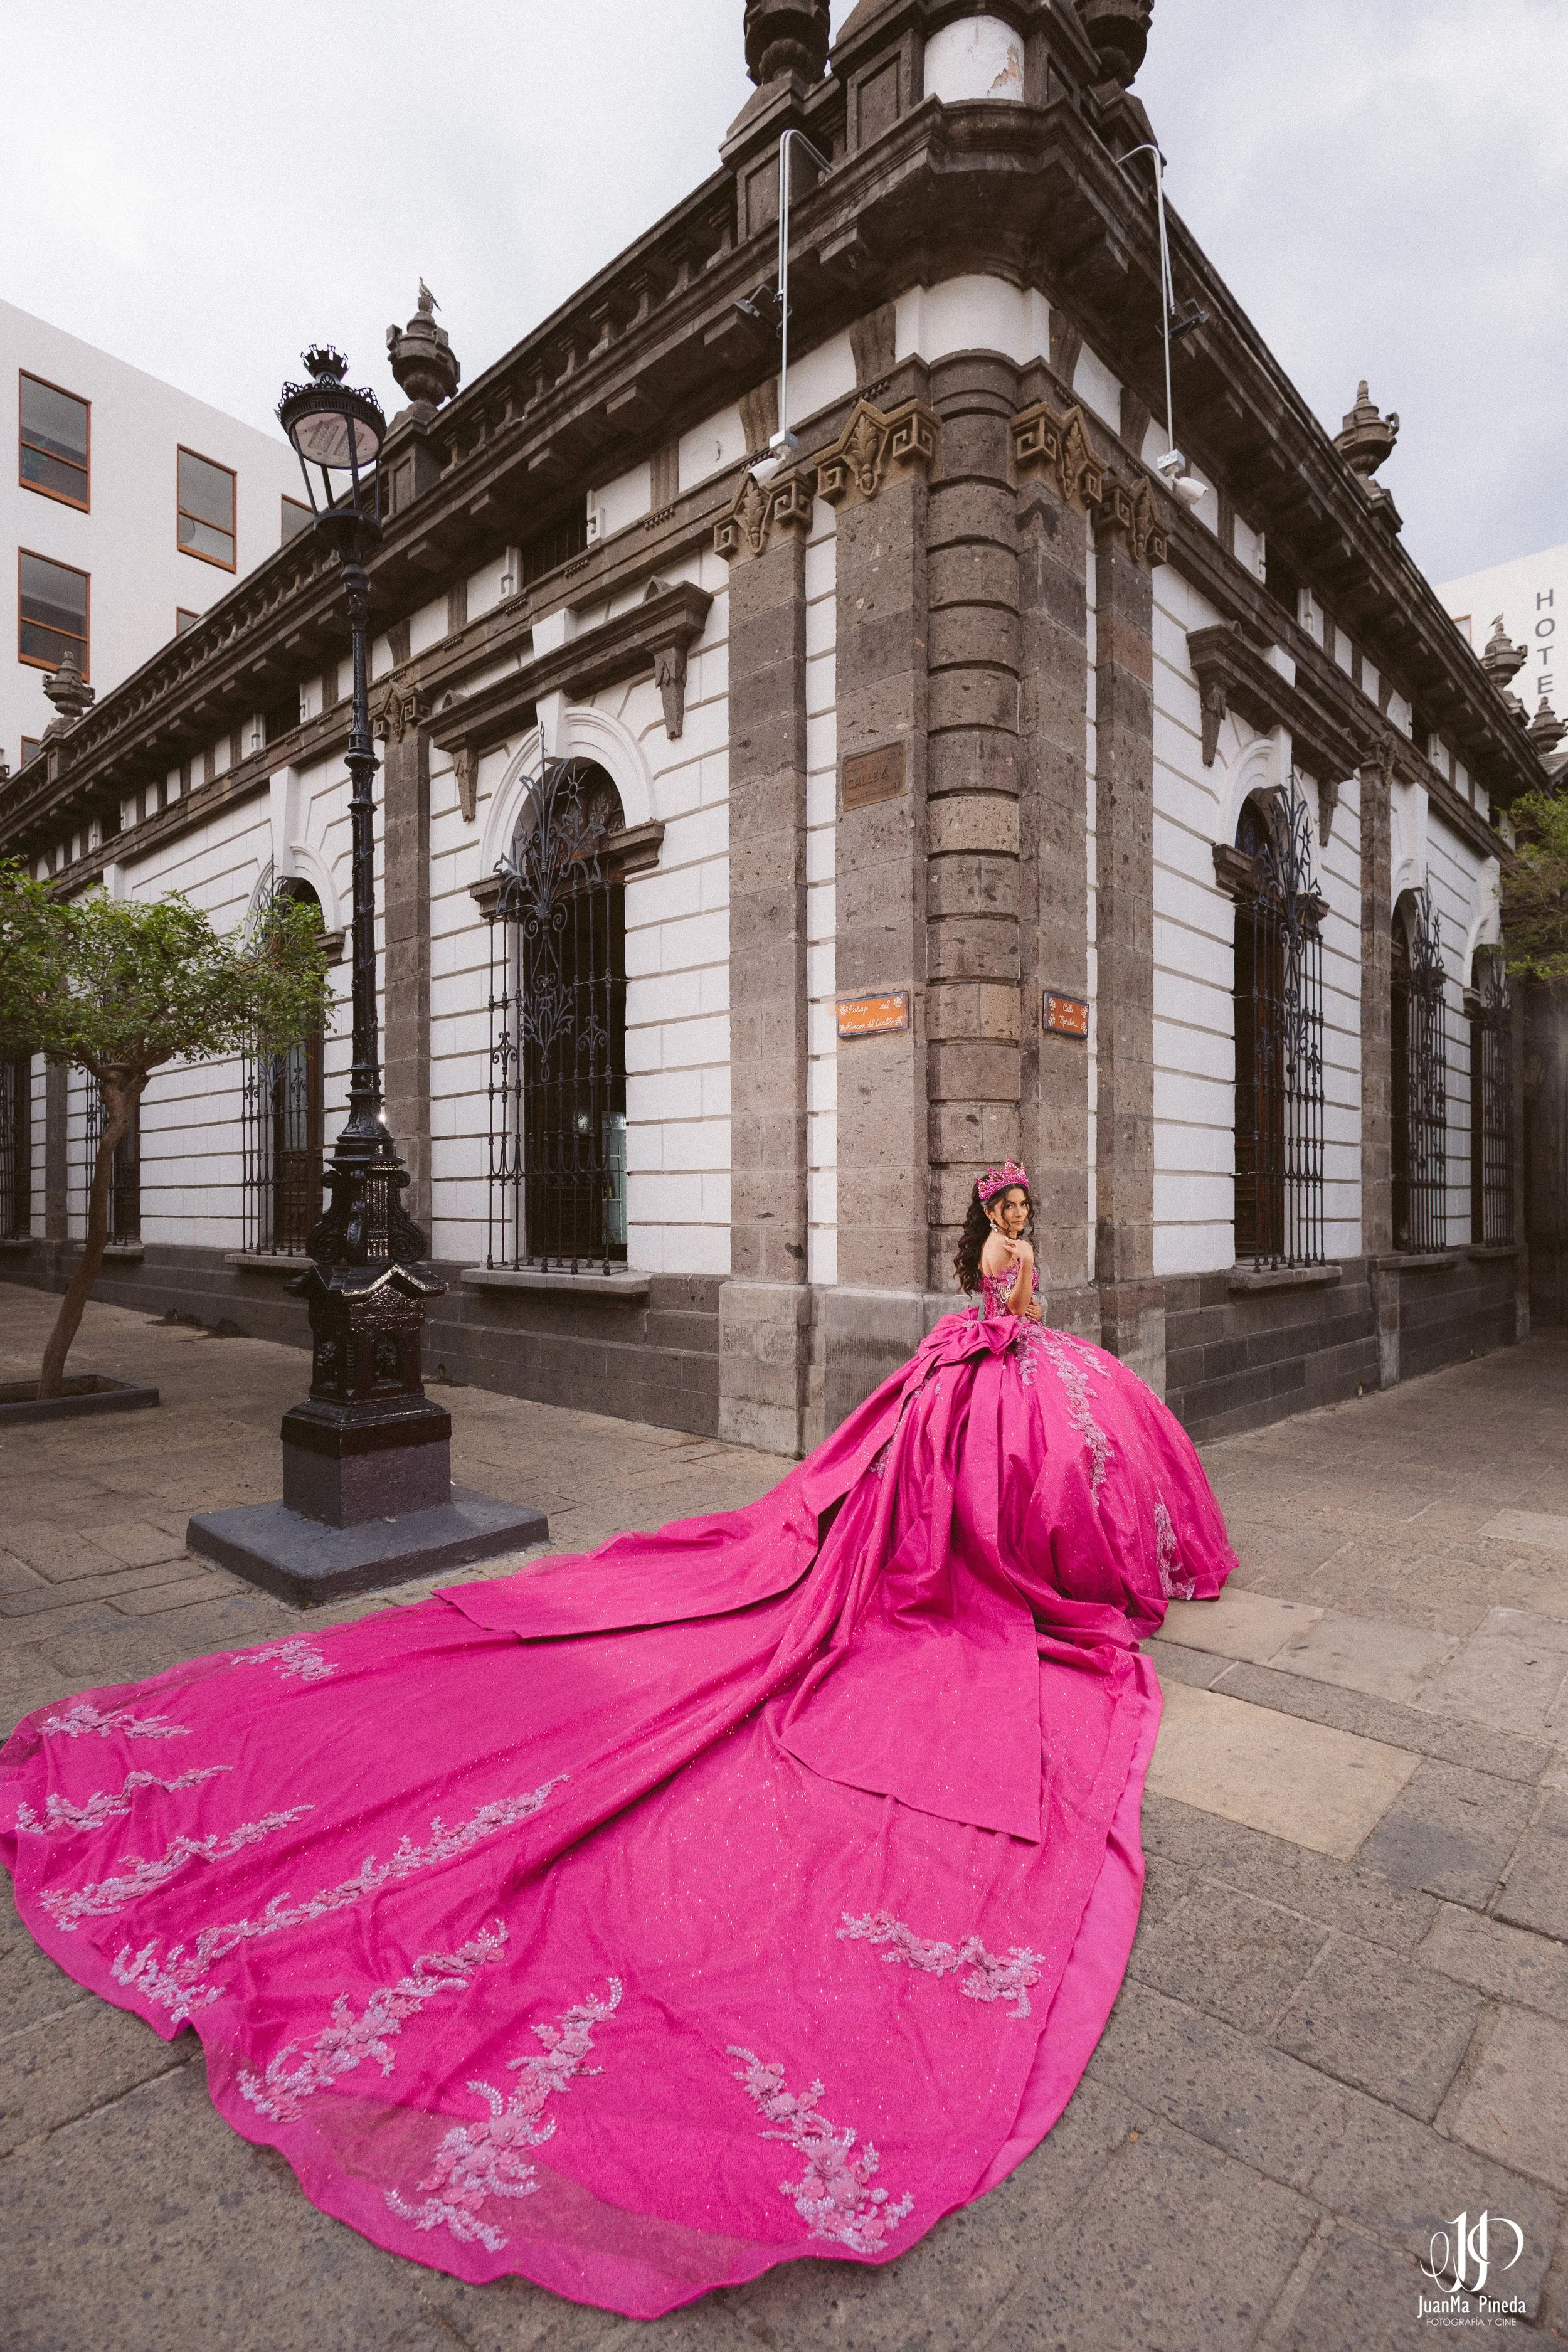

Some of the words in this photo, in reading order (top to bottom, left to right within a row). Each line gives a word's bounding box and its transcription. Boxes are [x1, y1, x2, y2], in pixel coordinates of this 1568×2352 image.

[1535, 589, 1555, 695] HOTE
[849, 771, 878, 789] CALLE
[881, 765, 889, 781] 4
[879, 1000, 890, 1009] del
[867, 1019, 875, 1028] del
[876, 1017, 894, 1027] Diablo
